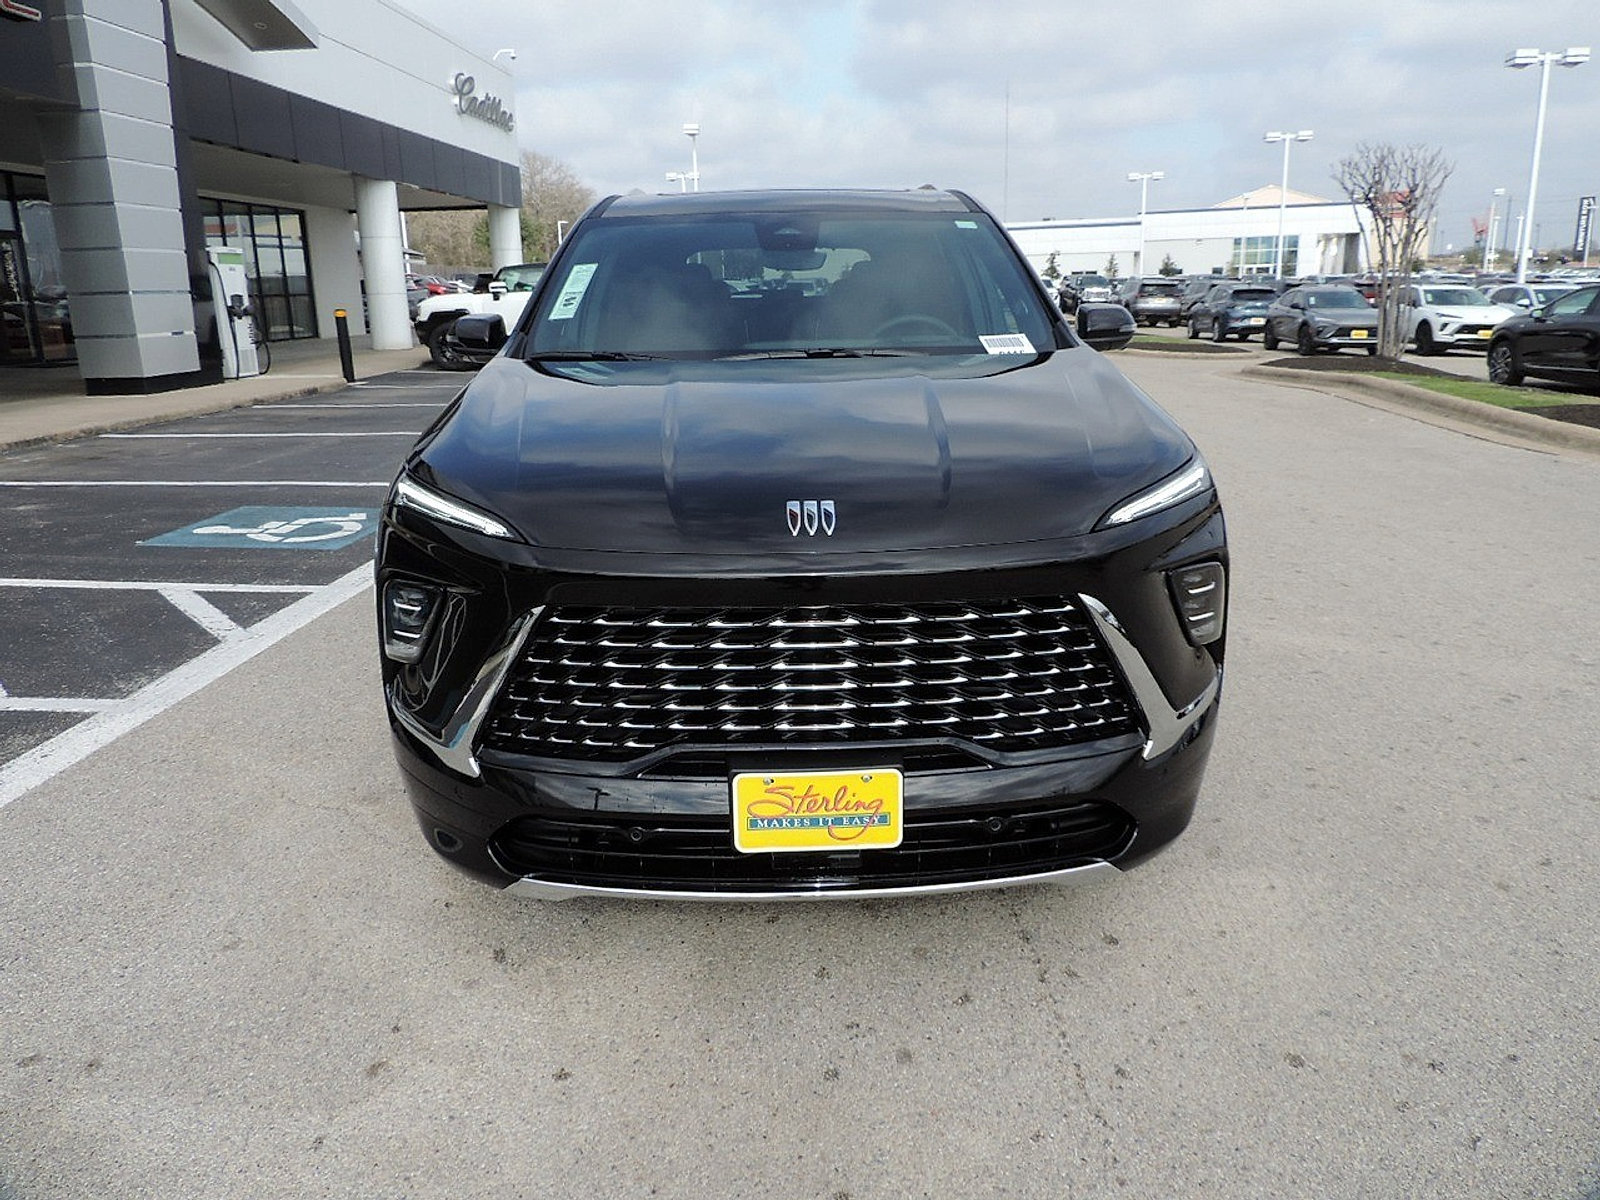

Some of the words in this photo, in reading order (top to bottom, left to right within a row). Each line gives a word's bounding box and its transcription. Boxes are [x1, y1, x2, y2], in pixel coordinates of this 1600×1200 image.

[454, 72, 515, 132] Cadillac
[747, 784, 883, 840] Sterling
[757, 817, 811, 828] MAKES
[819, 817, 835, 826] IT
[843, 815, 881, 825] EASY
